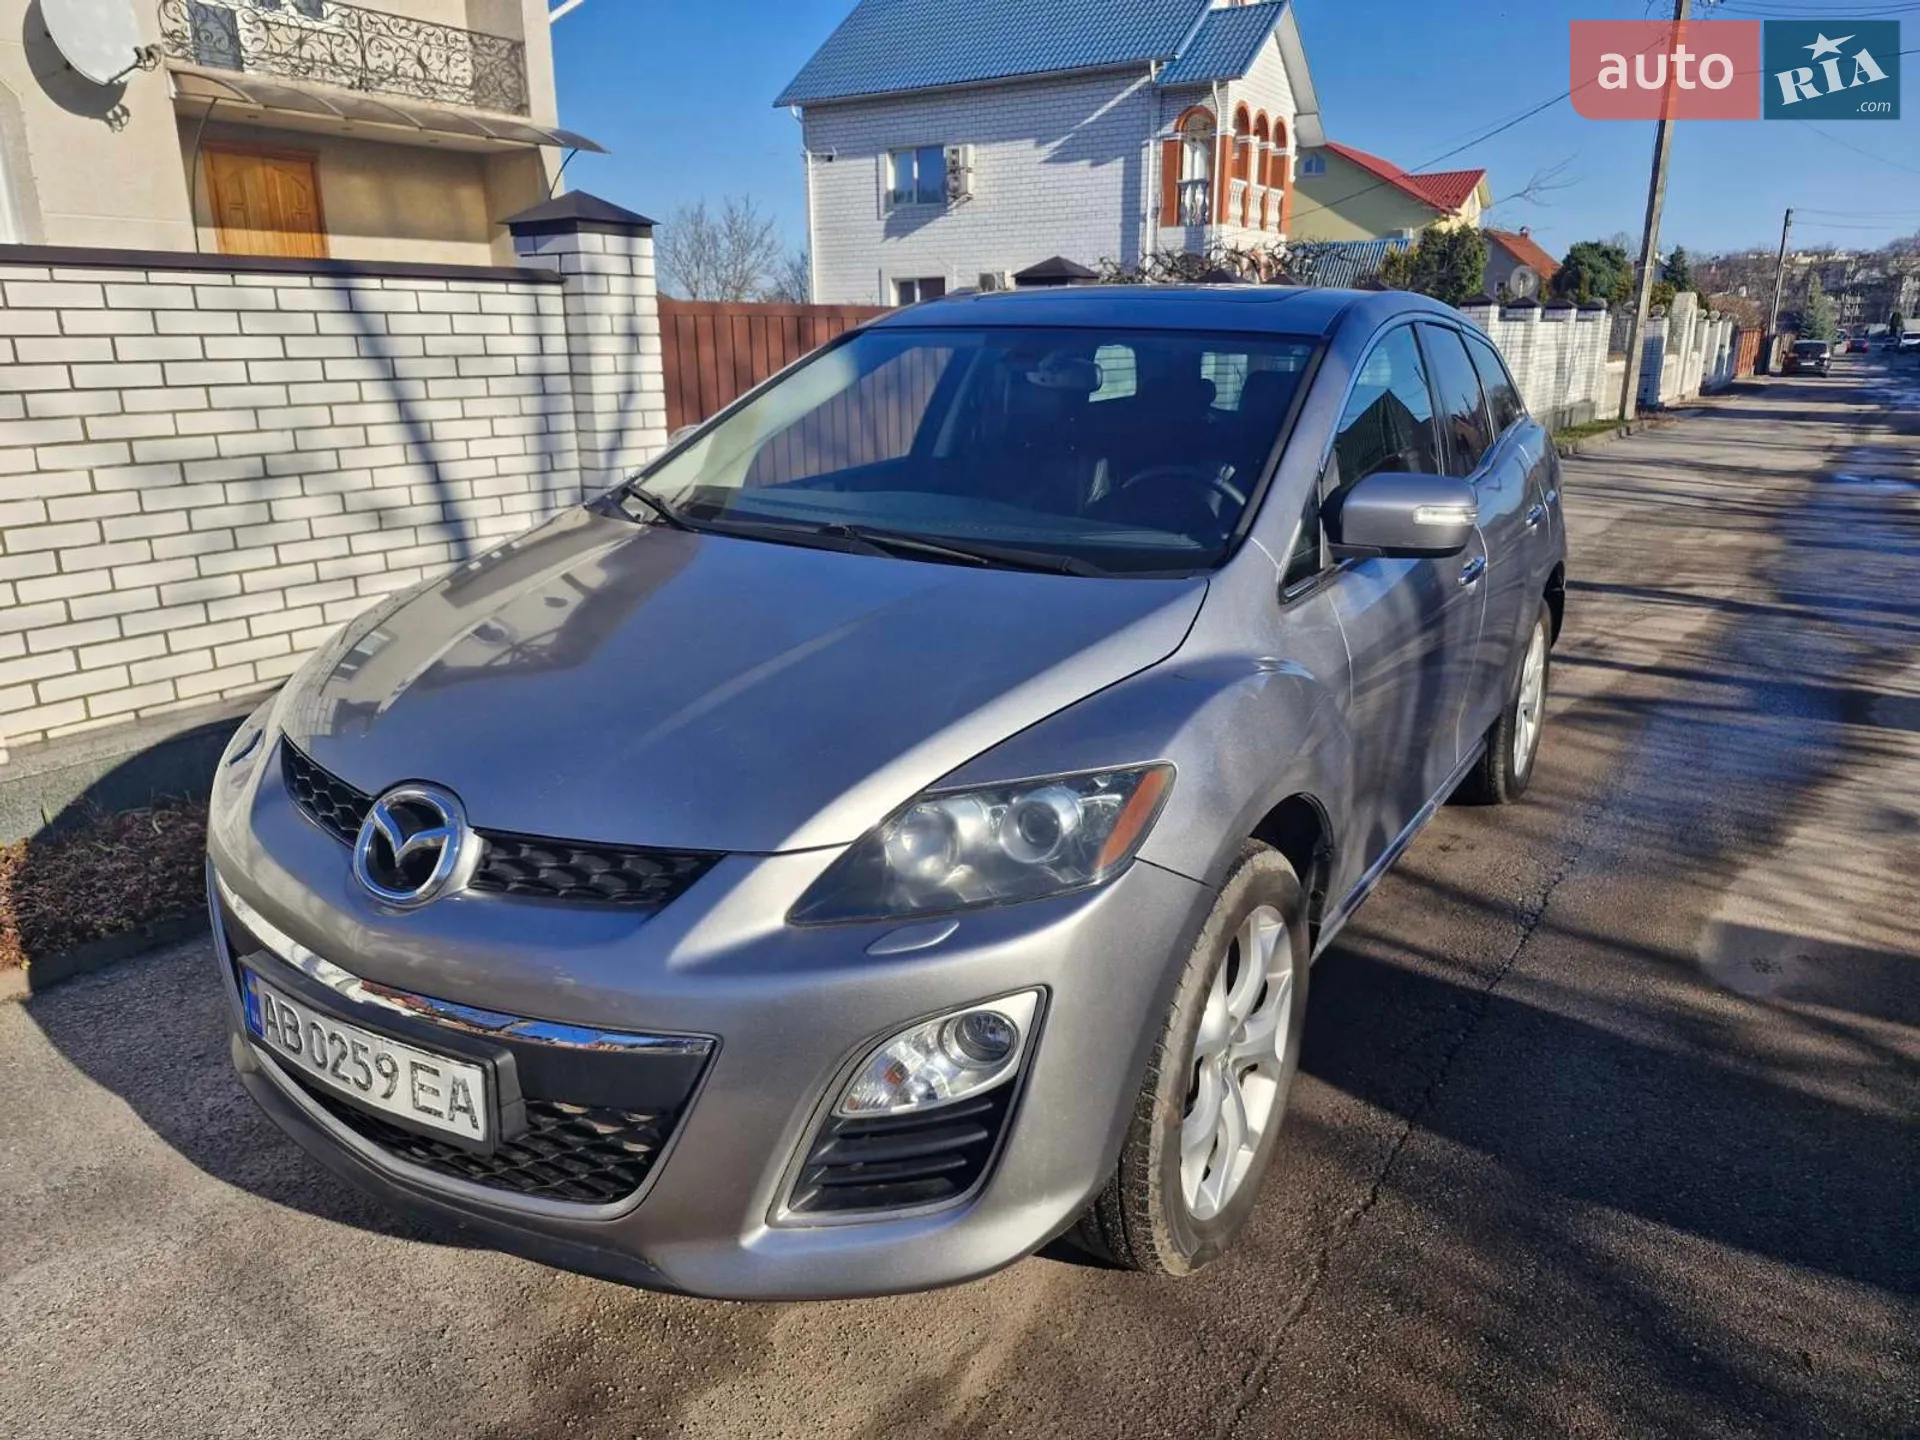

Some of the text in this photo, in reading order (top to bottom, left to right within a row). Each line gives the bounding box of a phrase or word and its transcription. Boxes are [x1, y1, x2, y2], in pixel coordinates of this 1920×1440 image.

[264, 991, 480, 1131] AB 0259 EA
